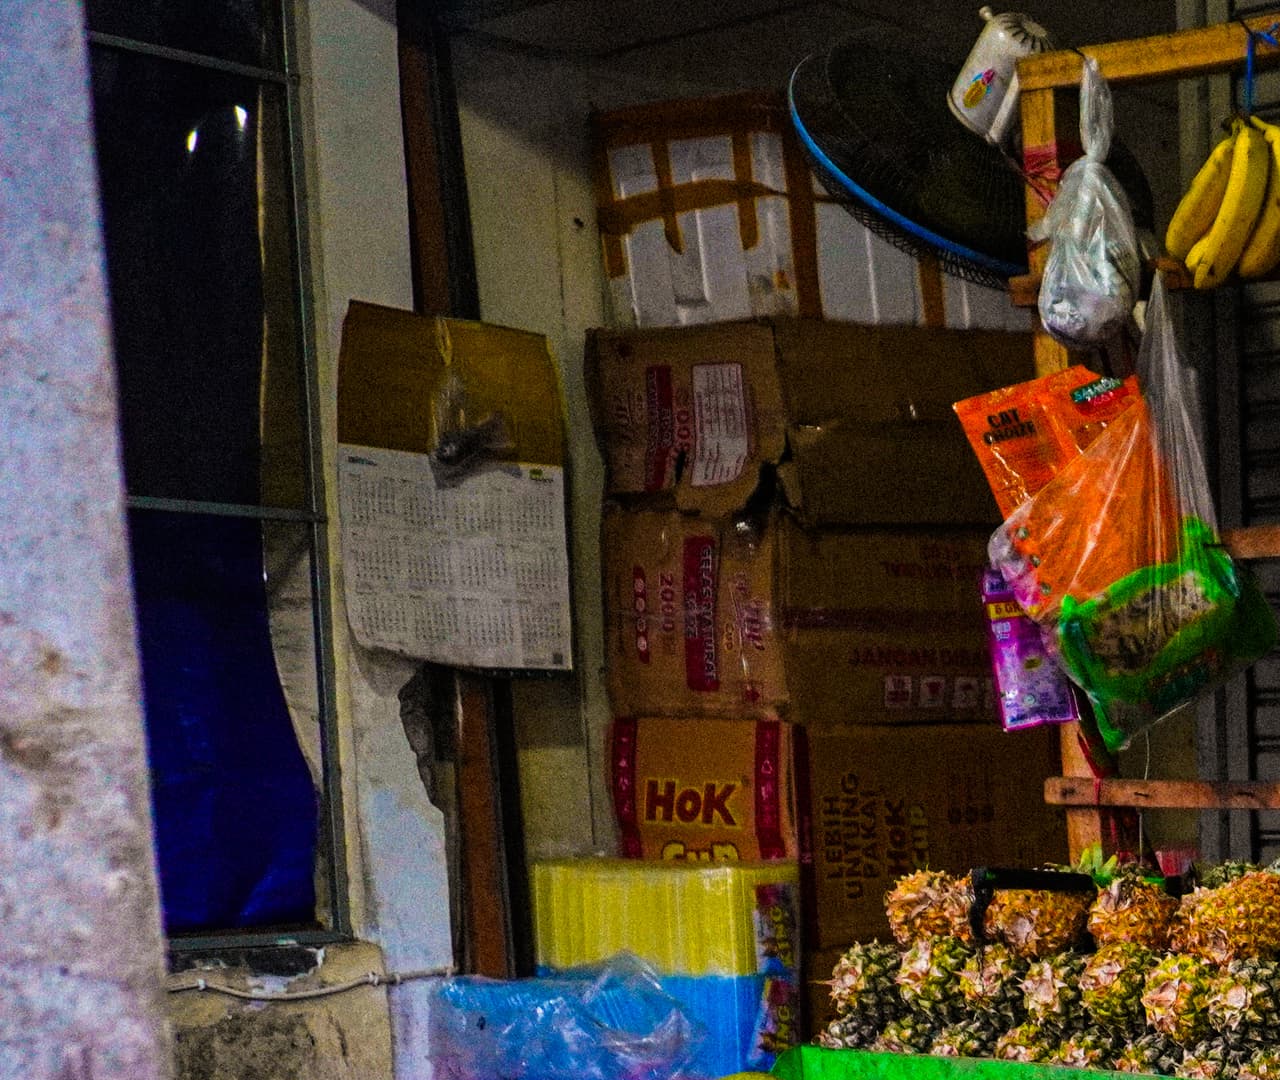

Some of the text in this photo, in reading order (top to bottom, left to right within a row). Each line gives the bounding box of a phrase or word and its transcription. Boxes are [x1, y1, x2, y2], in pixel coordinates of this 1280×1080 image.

[987, 408, 1021, 428] CAT
[660, 573, 675, 632] 2000
[822, 797, 843, 880] LEBIH
[841, 772, 864, 900] UNTUNG
[860, 789, 881, 878] PAKAI
